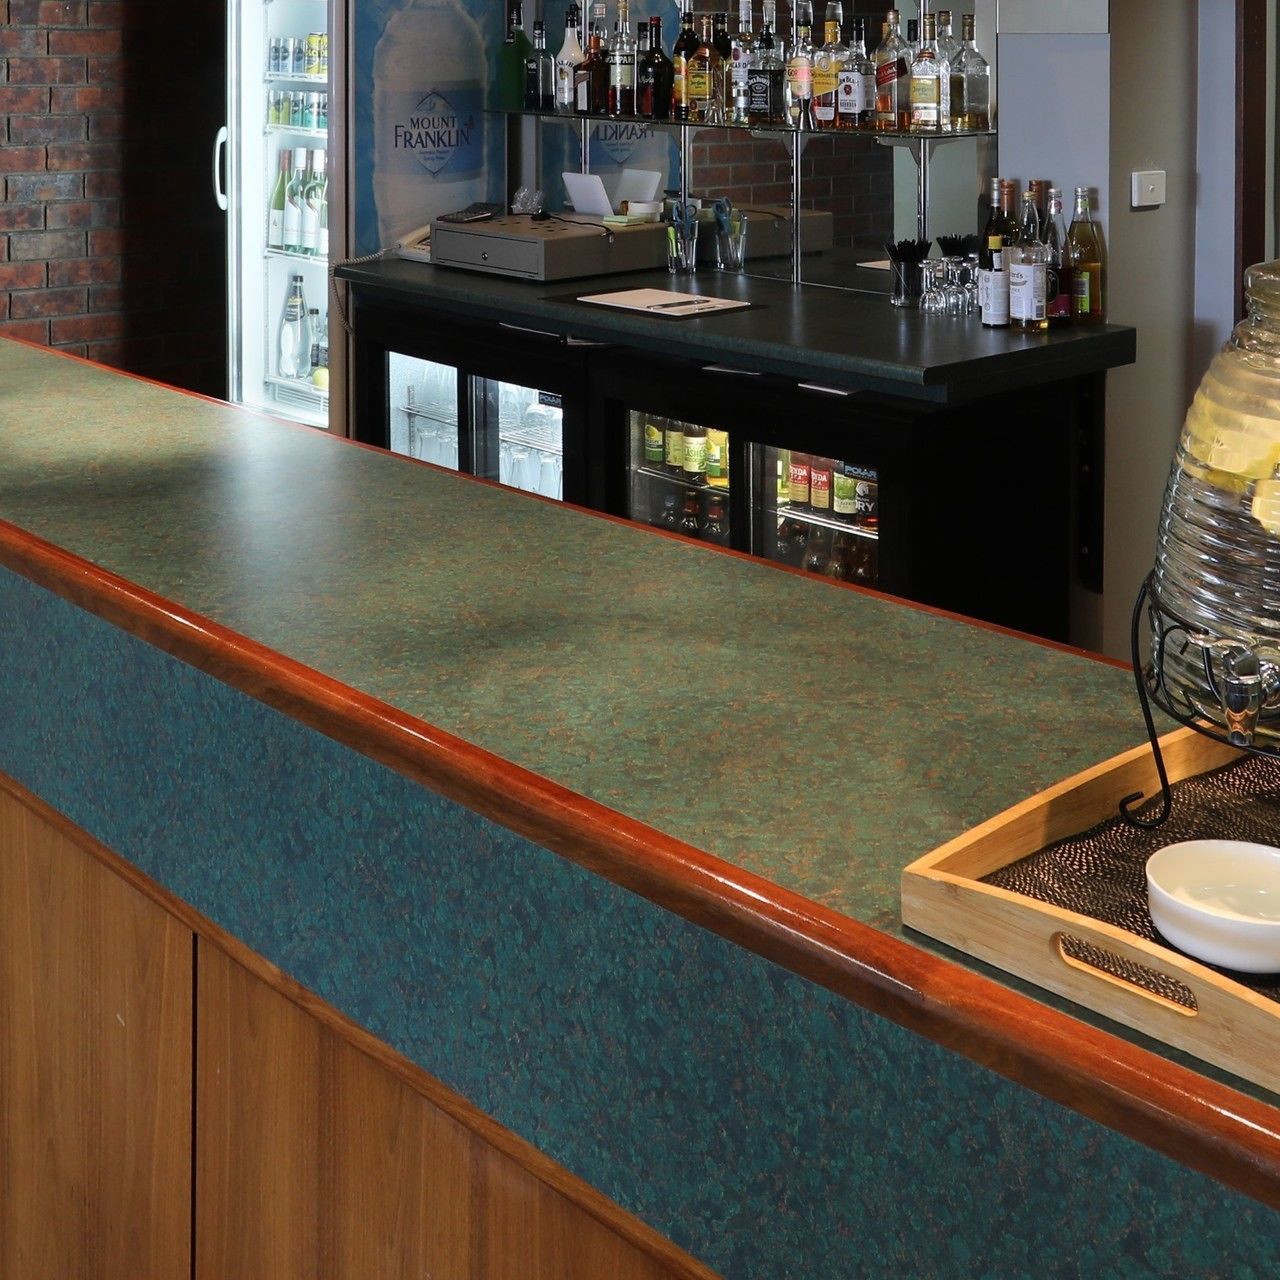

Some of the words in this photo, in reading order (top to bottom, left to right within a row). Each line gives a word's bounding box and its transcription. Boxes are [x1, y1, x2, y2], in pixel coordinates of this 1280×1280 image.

[410, 116, 457, 130] MOUNT
[394, 124, 471, 149] FRANKLIN
[844, 464, 878, 479] POLAR
